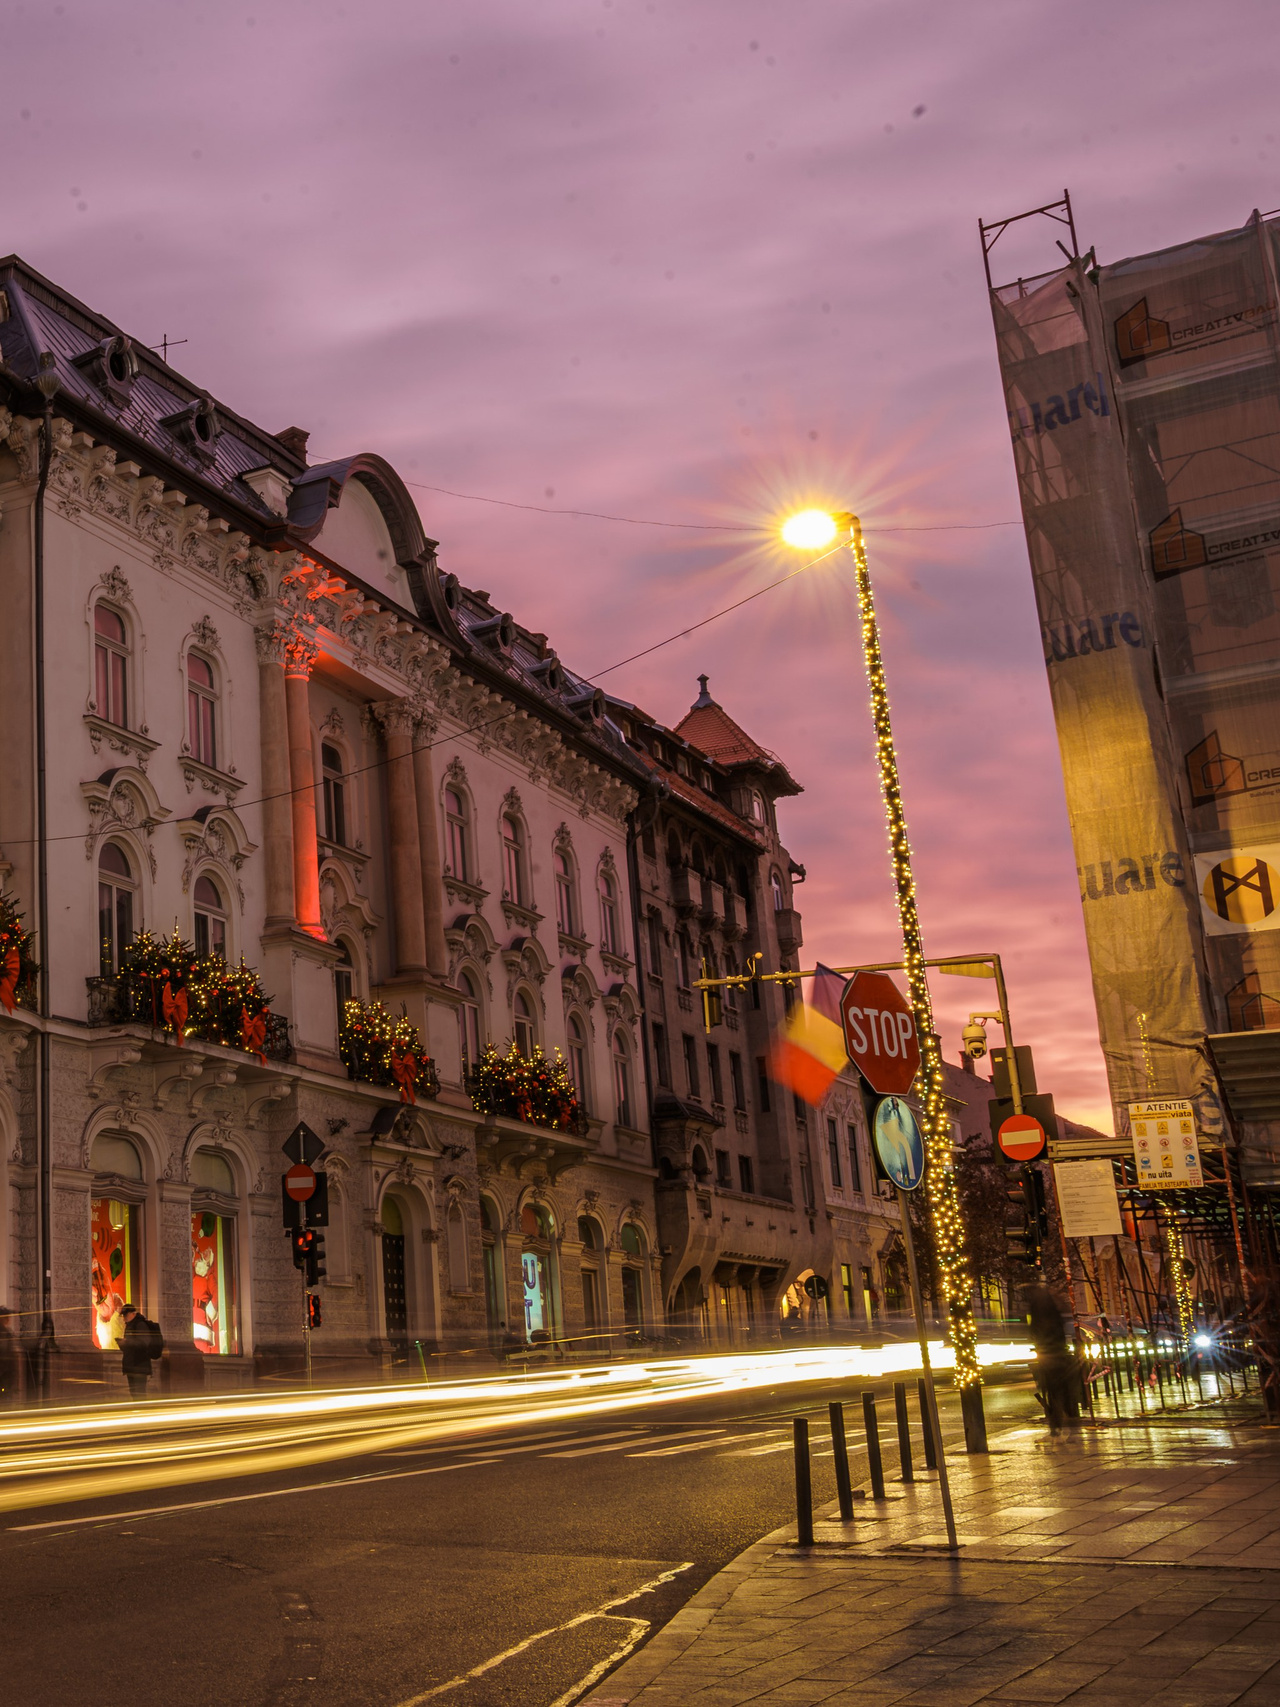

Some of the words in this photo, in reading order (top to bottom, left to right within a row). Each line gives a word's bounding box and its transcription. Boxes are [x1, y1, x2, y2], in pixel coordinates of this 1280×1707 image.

[1076, 851, 1186, 903] uare
[848, 1006, 913, 1059] STOP
[1146, 1101, 1188, 1112] ATENTIE
[1170, 1110, 1192, 1118] viata
[1147, 1171, 1157, 1179] nu
[1158, 1170, 1173, 1179] uita
